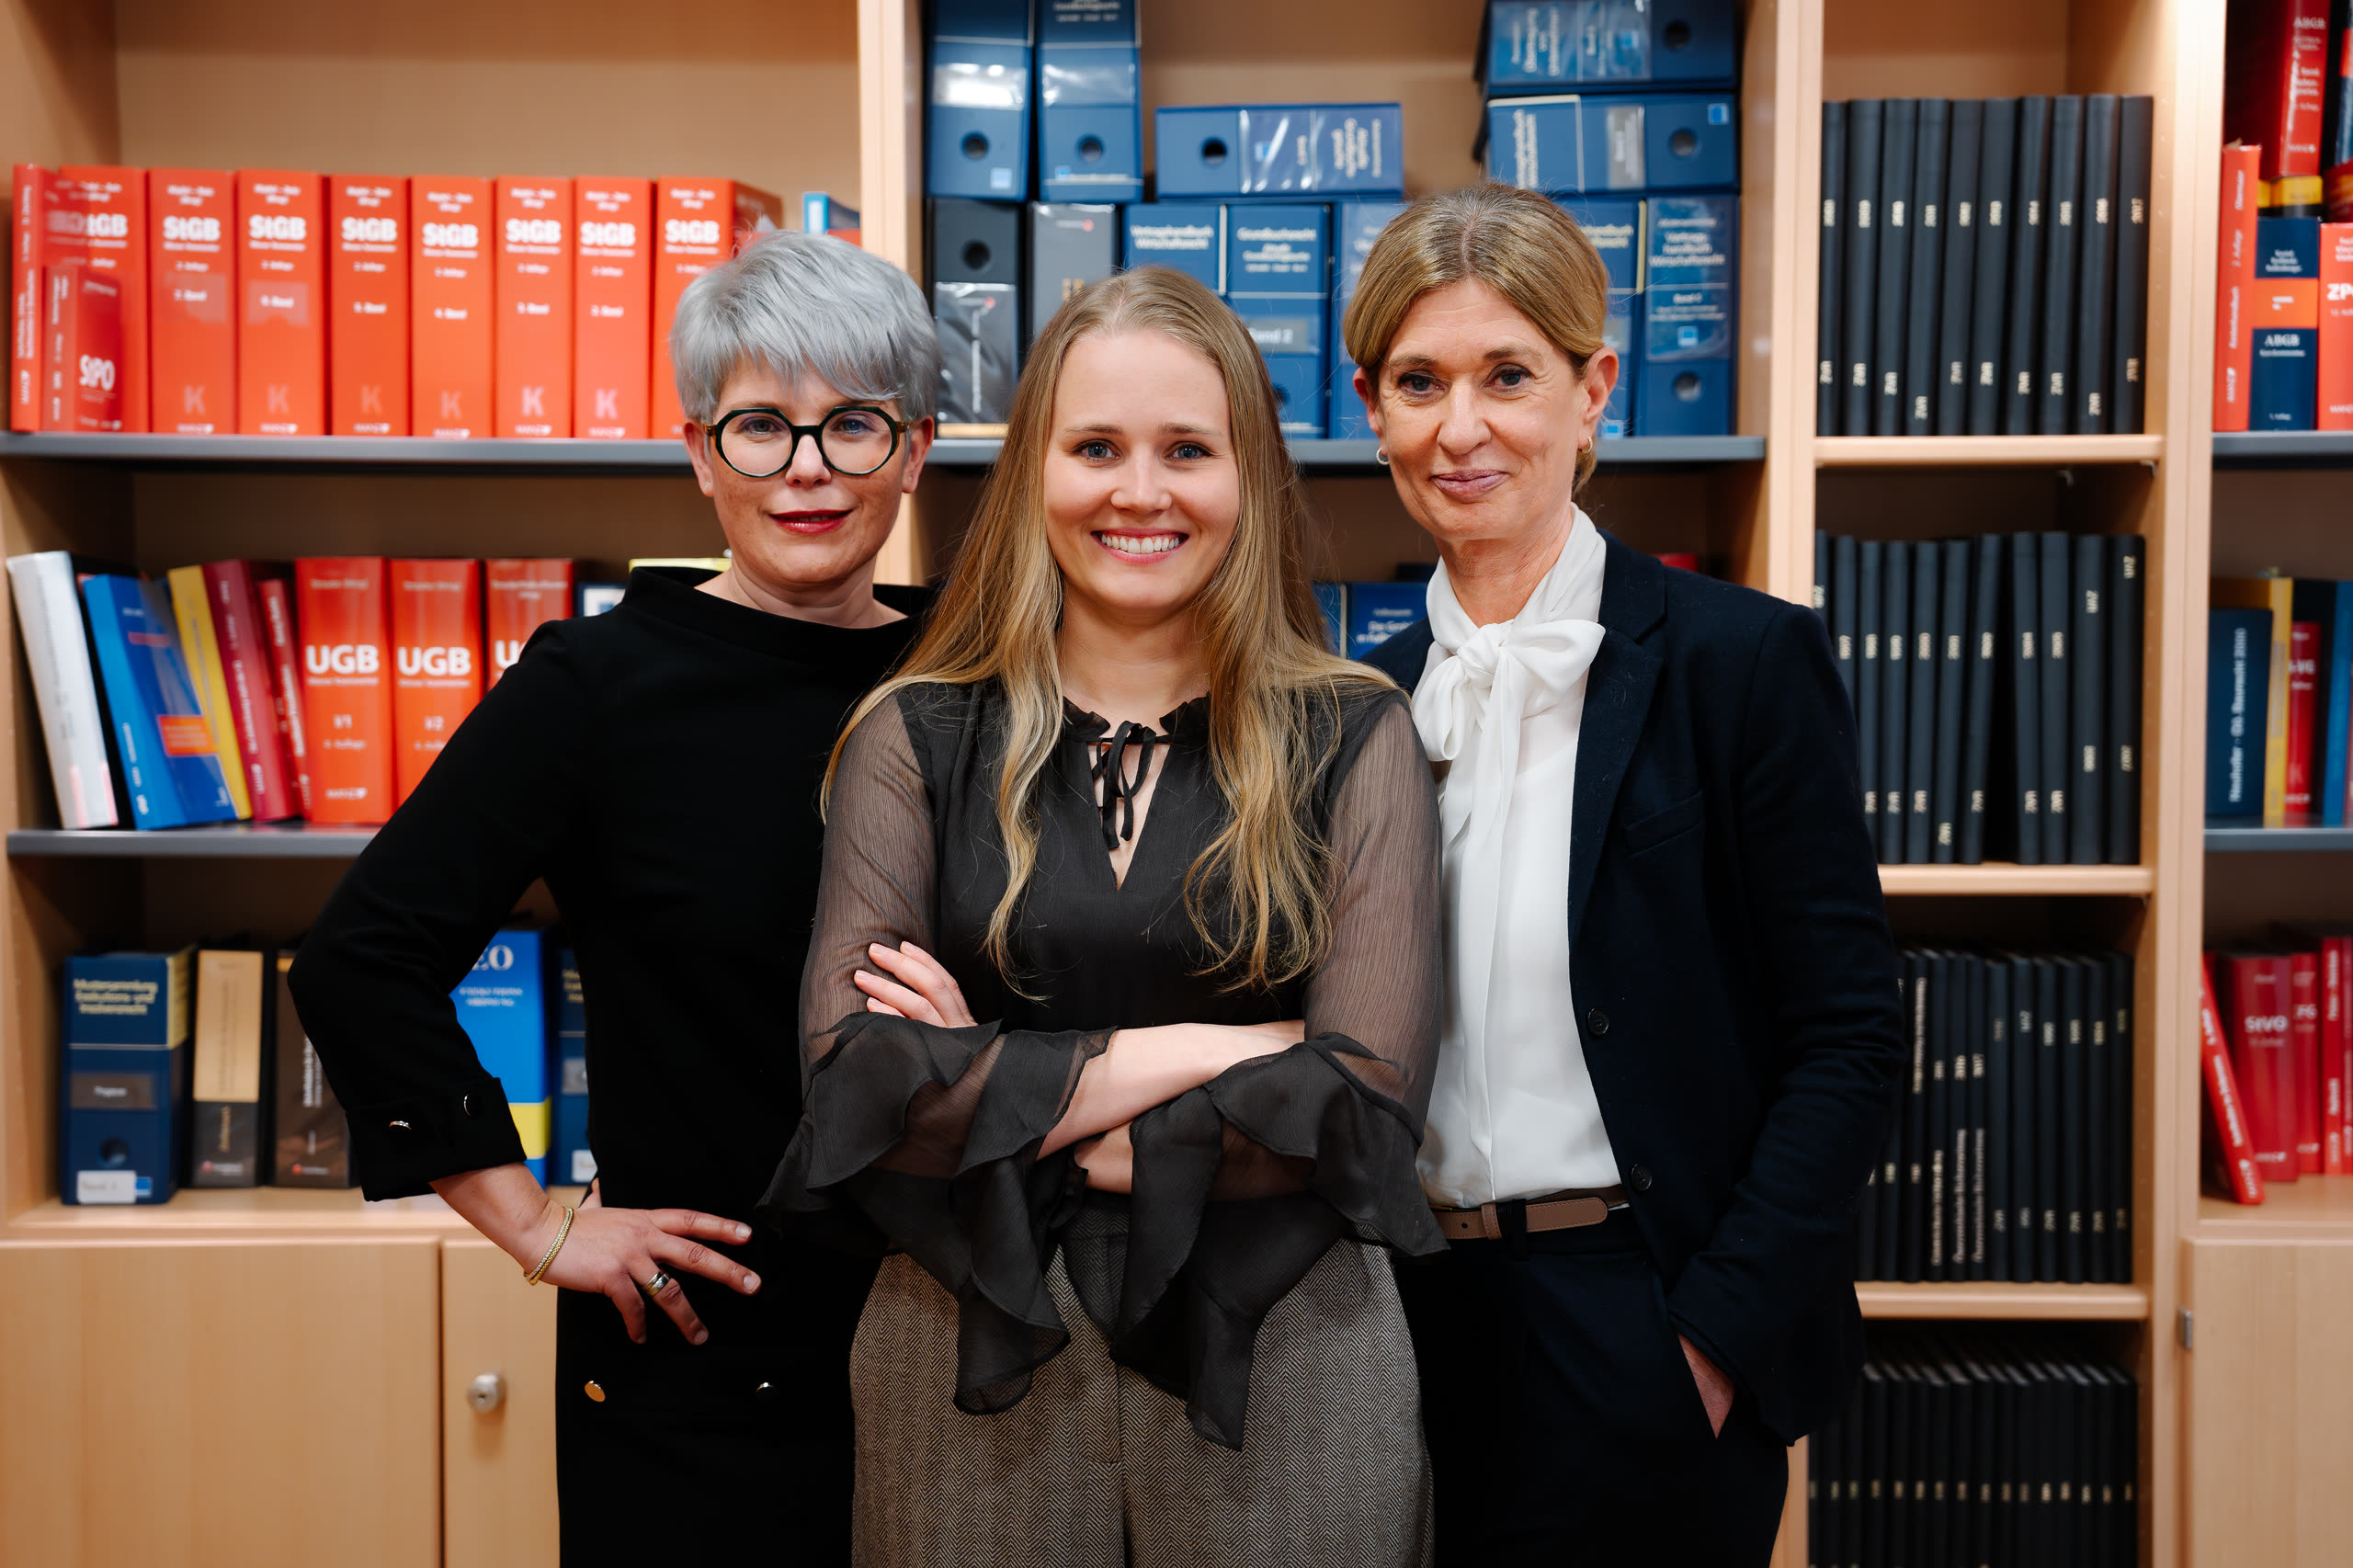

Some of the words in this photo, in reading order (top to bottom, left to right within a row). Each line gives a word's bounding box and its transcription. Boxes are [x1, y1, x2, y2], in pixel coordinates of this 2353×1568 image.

[2327, 283, 2353, 301] ZP
[307, 645, 379, 674] UGB
[399, 647, 471, 676] UGB
[494, 641, 527, 669] U
